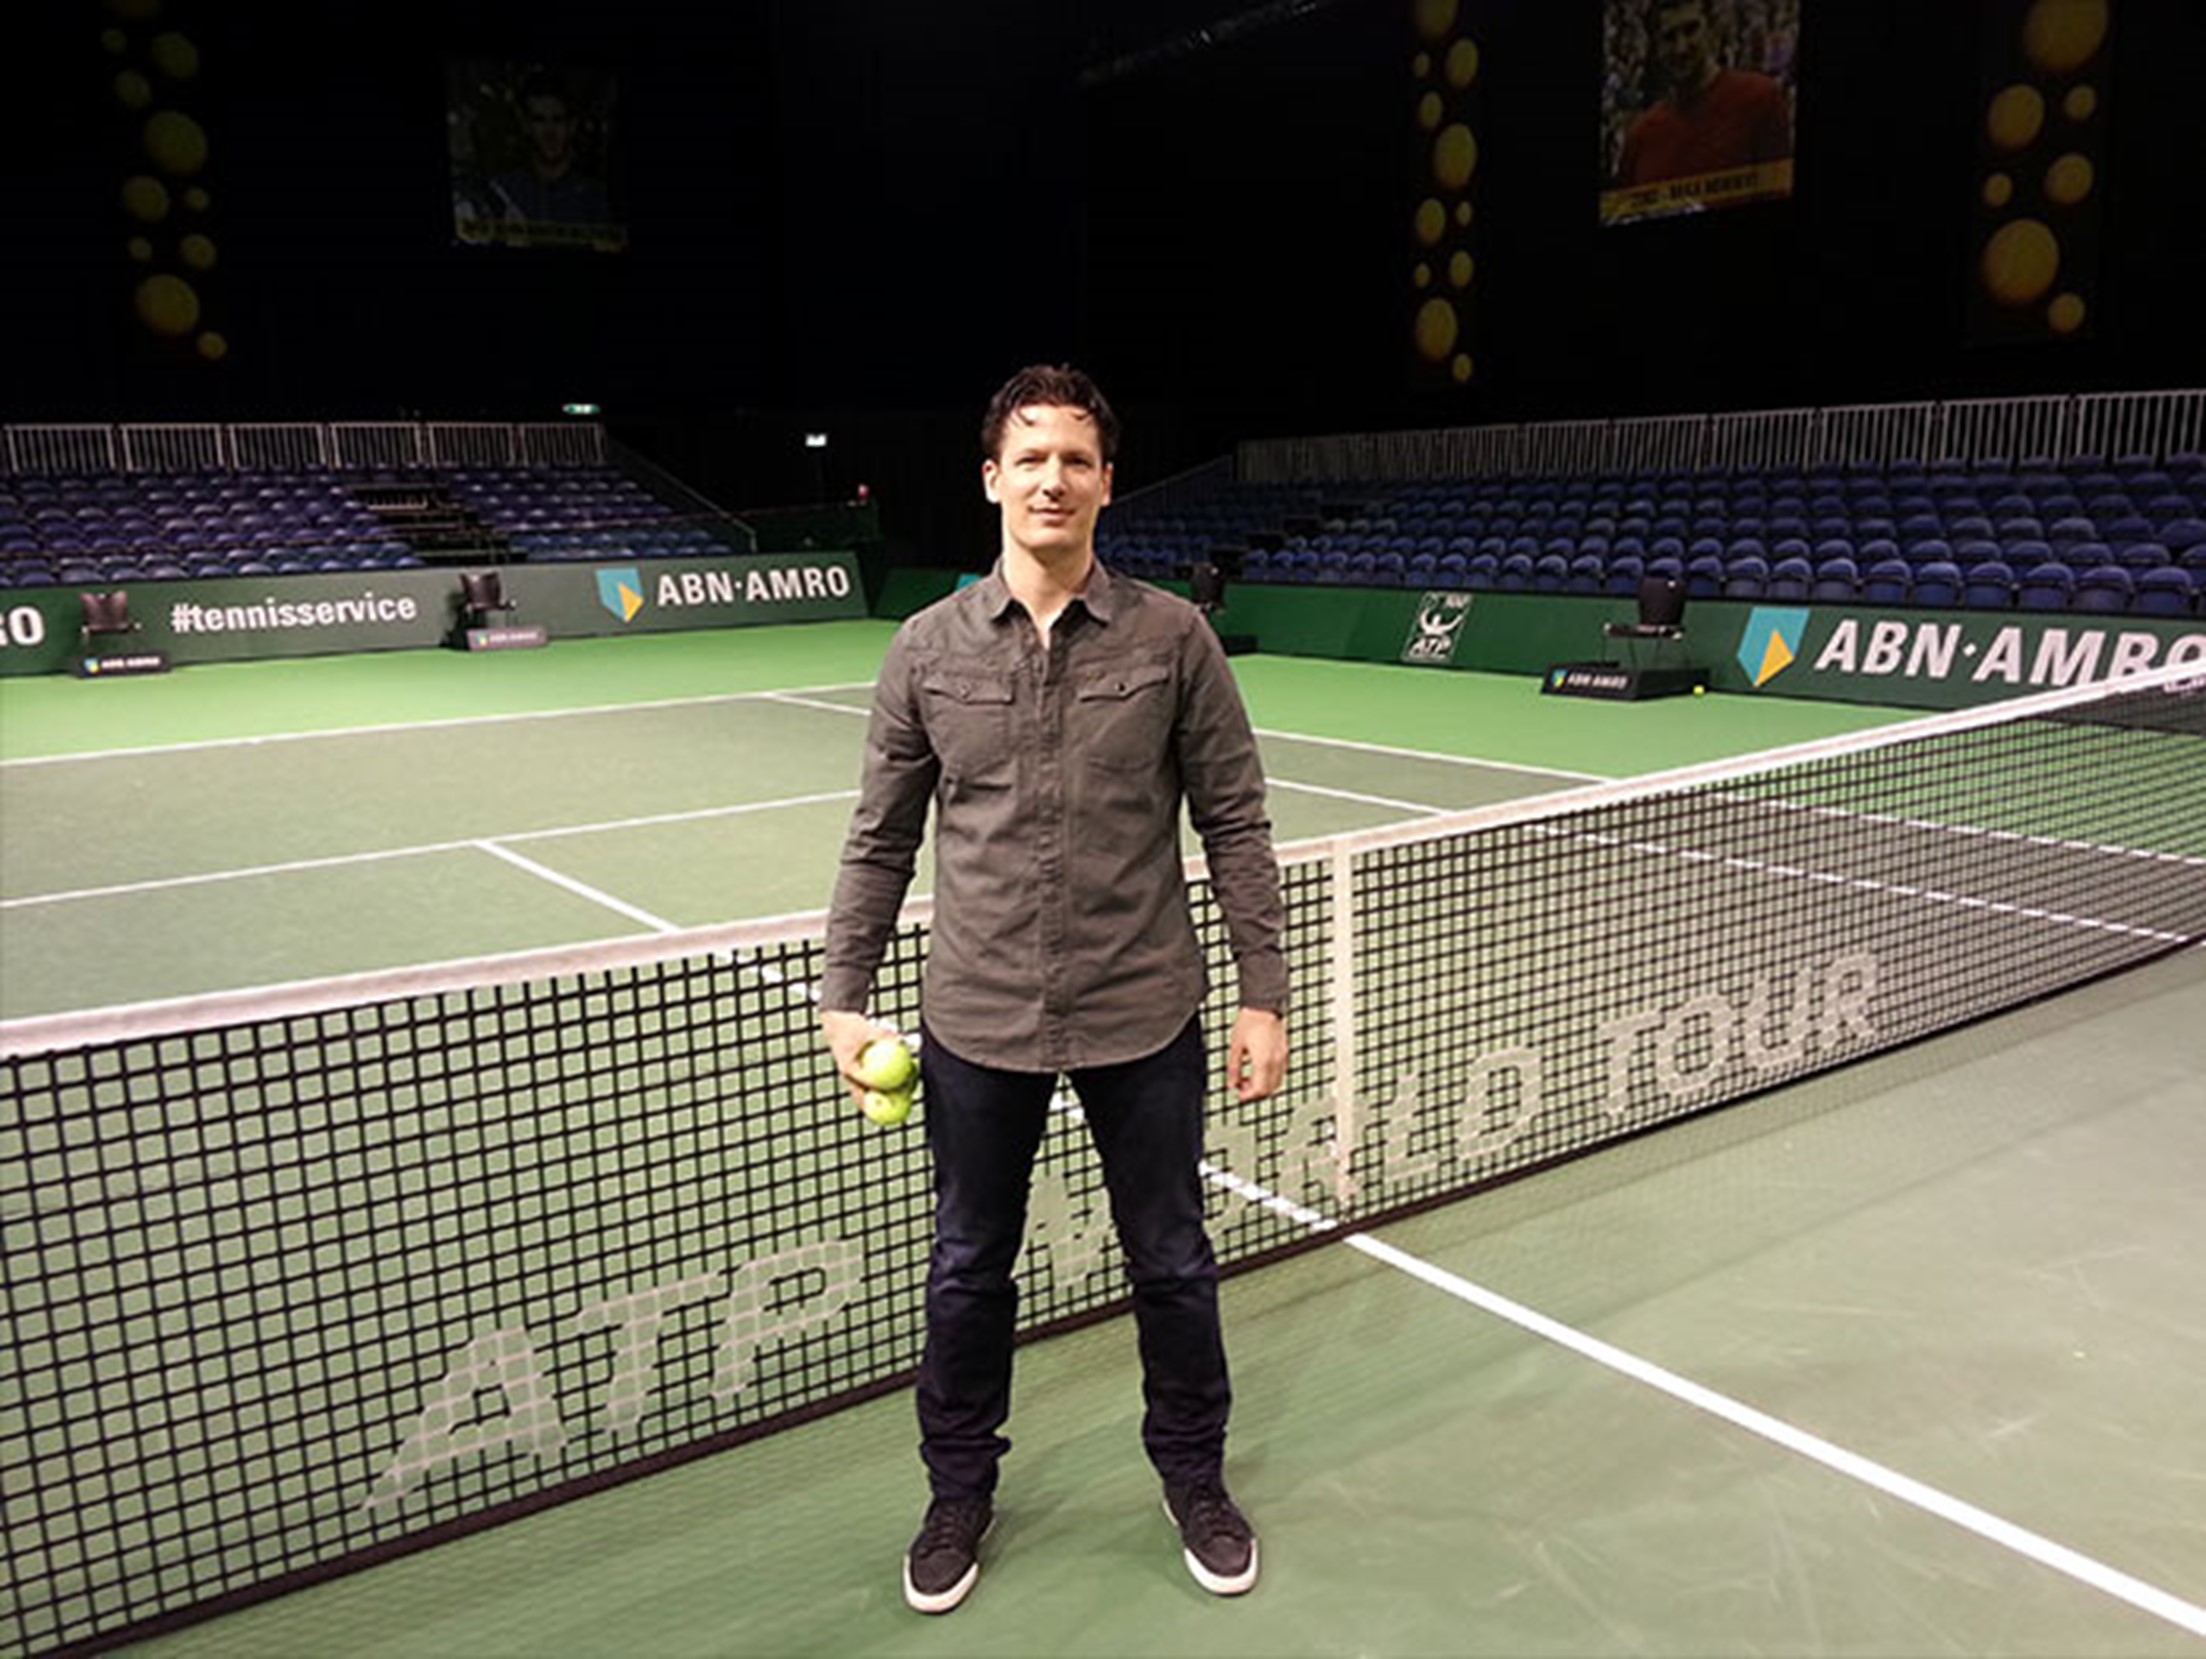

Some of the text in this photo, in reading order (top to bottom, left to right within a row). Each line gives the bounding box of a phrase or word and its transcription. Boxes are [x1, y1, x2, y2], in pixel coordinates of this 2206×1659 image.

[0, 606, 44, 646] O
[171, 591, 416, 632] #tennisservice
[361, 1238, 866, 1510] ATP
[1597, 952, 1879, 1115] TOUR
